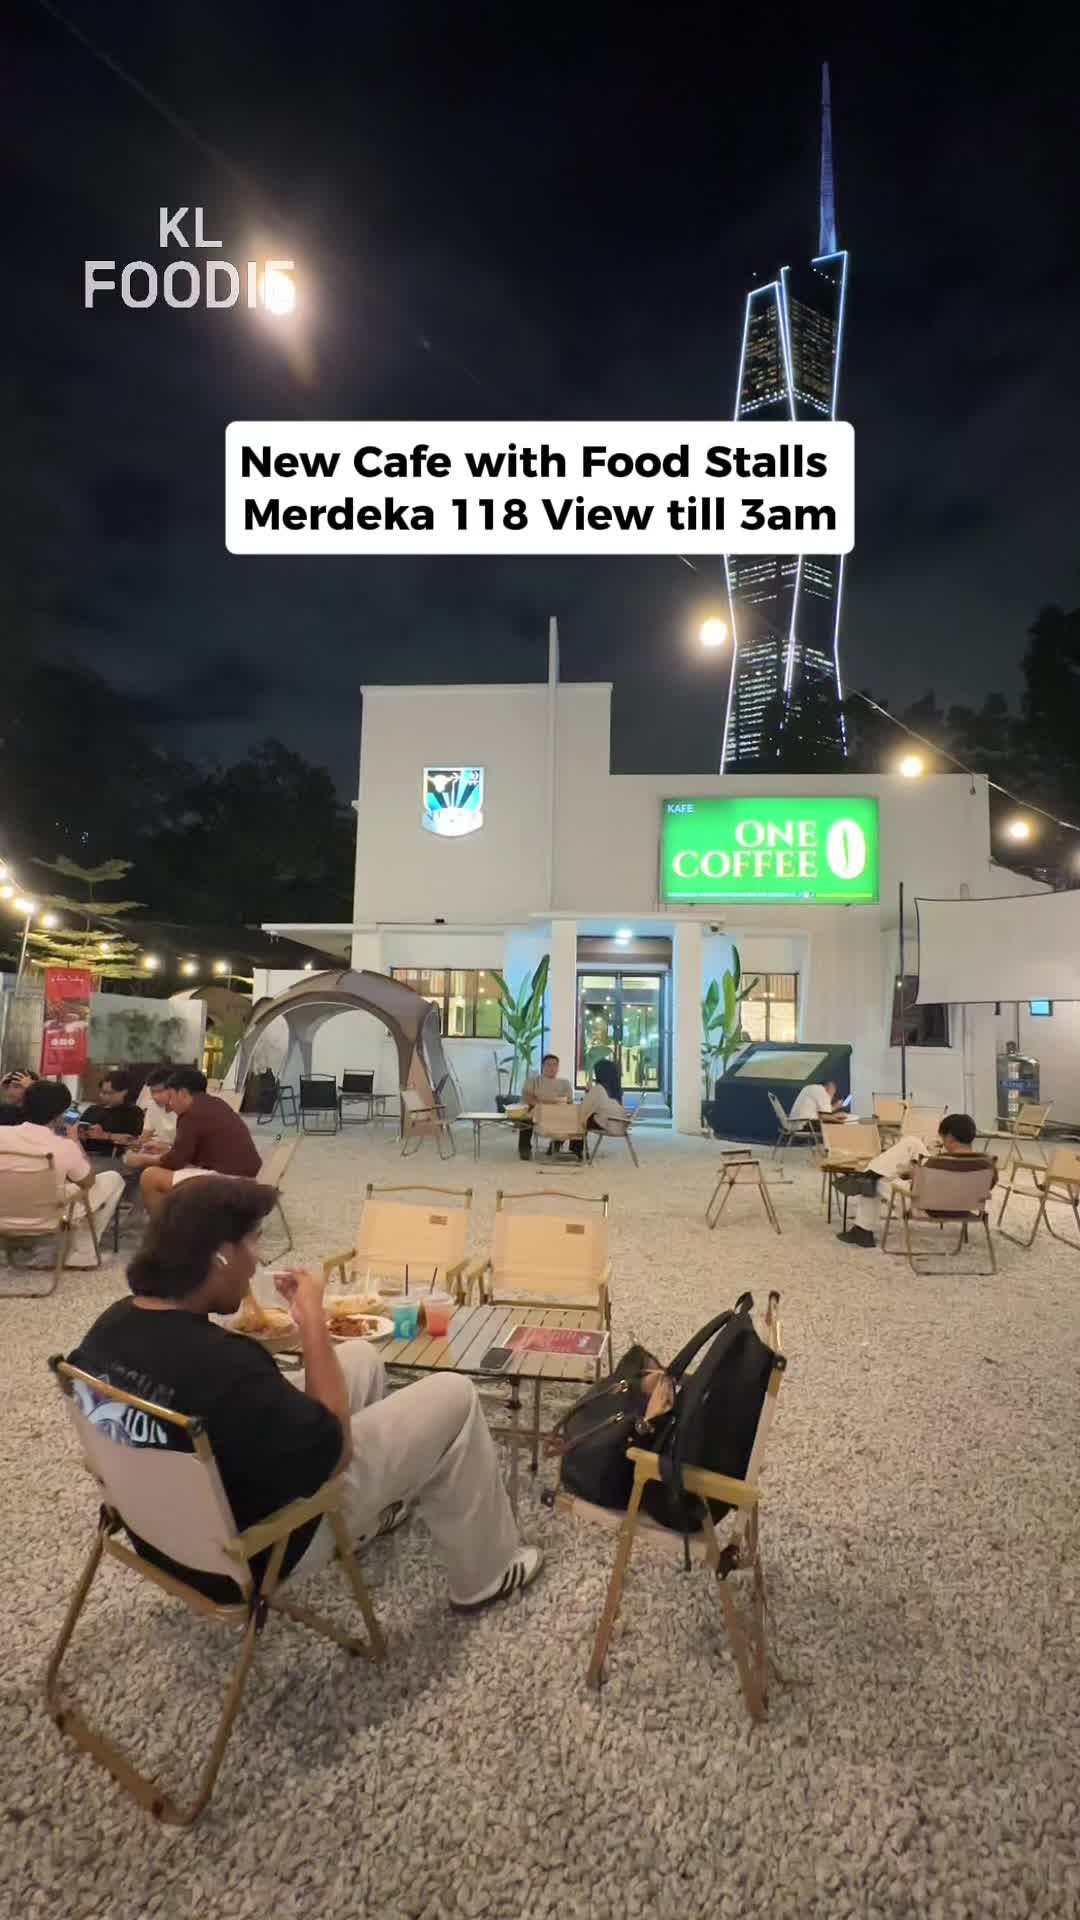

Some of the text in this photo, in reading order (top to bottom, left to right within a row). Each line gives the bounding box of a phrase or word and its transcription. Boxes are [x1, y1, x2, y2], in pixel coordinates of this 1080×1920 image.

[667, 803, 694, 814] KAFE
[735, 820, 817, 848] ONE
[672, 850, 818, 878] COFFEE
